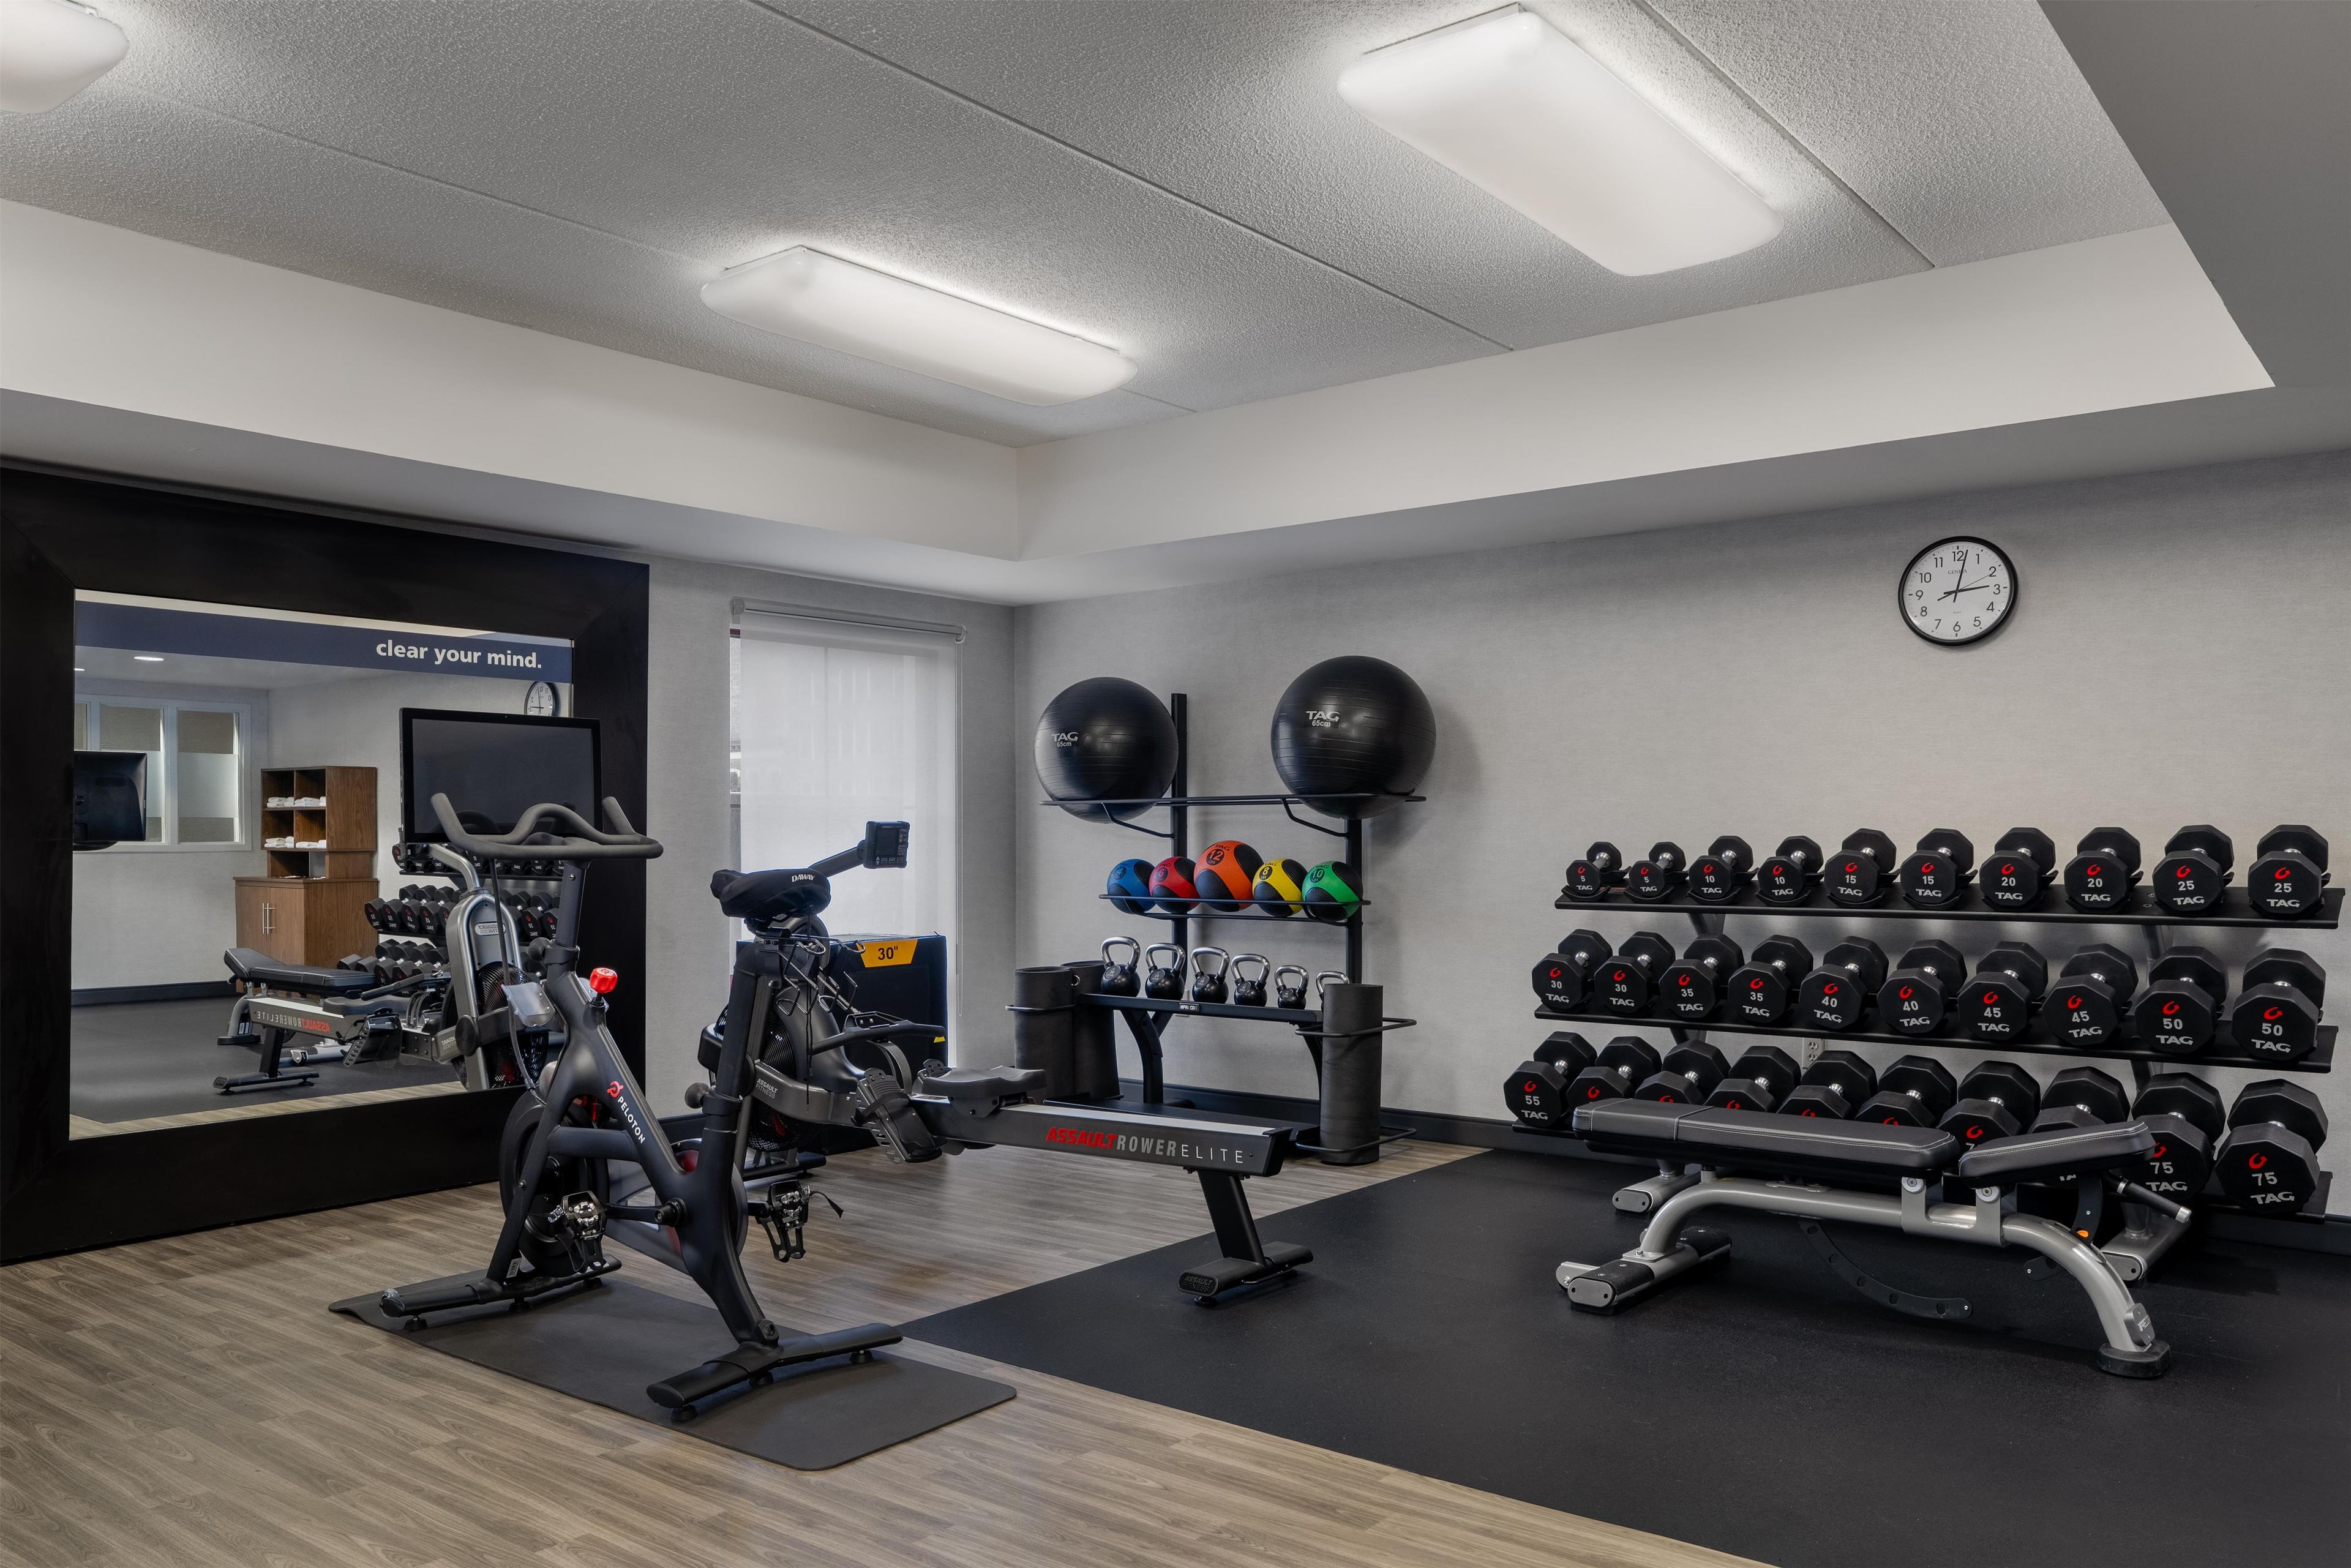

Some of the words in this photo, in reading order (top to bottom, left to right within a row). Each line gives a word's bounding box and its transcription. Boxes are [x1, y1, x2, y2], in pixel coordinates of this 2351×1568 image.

[1952, 551, 1964, 561] 12
[1976, 553, 1980, 565] 1
[1935, 557, 1943, 568] 11
[1989, 566, 1996, 577] 2
[1919, 572, 1931, 583] 10
[1993, 584, 2001, 595] 3
[1915, 590, 1924, 600] 9
[1920, 606, 1927, 617] 8
[1986, 601, 1995, 612] 4
[1935, 619, 1941, 629] 7
[1953, 621, 1961, 632] 6
[1973, 617, 1981, 627] 5
[376, 640, 428, 659] clear
[434, 646, 481, 664] your
[487, 650, 542, 669] mind.
[1306, 711, 1341, 722] TAG
[1051, 732, 1078, 741] TAG
[1209, 850, 1223, 860] 12
[1262, 867, 1270, 876] 8
[1313, 869, 1323, 878] 10
[792, 874, 816, 882] DAWAY
[1845, 875, 1856, 883] 15
[2002, 877, 2015, 886] 20
[2088, 879, 2102, 887] 20
[2178, 880, 2194, 890] 25
[2274, 883, 2292, 892] 25
[1838, 887, 1862, 896] TAG
[2173, 896, 2204, 905] TAG
[878, 946, 898, 960] 30"
[1546, 994, 1569, 1003] TAG
[1750, 992, 1763, 1001] 35
[1610, 998, 1634, 1007] TAG
[1822, 997, 1837, 1007] 40
[1903, 1001, 1918, 1011] 40
[1743, 1005, 1769, 1016] TAG
[1984, 1007, 2001, 1018] 45
[1814, 1010, 1842, 1022] TAG
[2072, 1011, 2089, 1022] 45
[1900, 1017, 1930, 1026] TAG
[2163, 1018, 2183, 1029] 50
[1978, 1023, 2009, 1032] TAG
[2069, 1027, 2102, 1037] TAG
[2262, 1023, 2282, 1035] 50
[2156, 1035, 2193, 1045] TAG
[2252, 1039, 2290, 1052] TAG
[757, 1078, 778, 1093] ASSAULT
[756, 1084, 776, 1098] FITNESS
[1526, 1095, 1540, 1105] 55
[617, 1096, 645, 1144] PELOTON
[1521, 1110, 1548, 1120] TAG
[2150, 1162, 2173, 1174] 75
[2252, 1172, 2277, 1185] 75
[2146, 1182, 2187, 1191] TAG
[2251, 1192, 2294, 1204] TAG
[1184, 1275, 1213, 1286] ASSAULT
